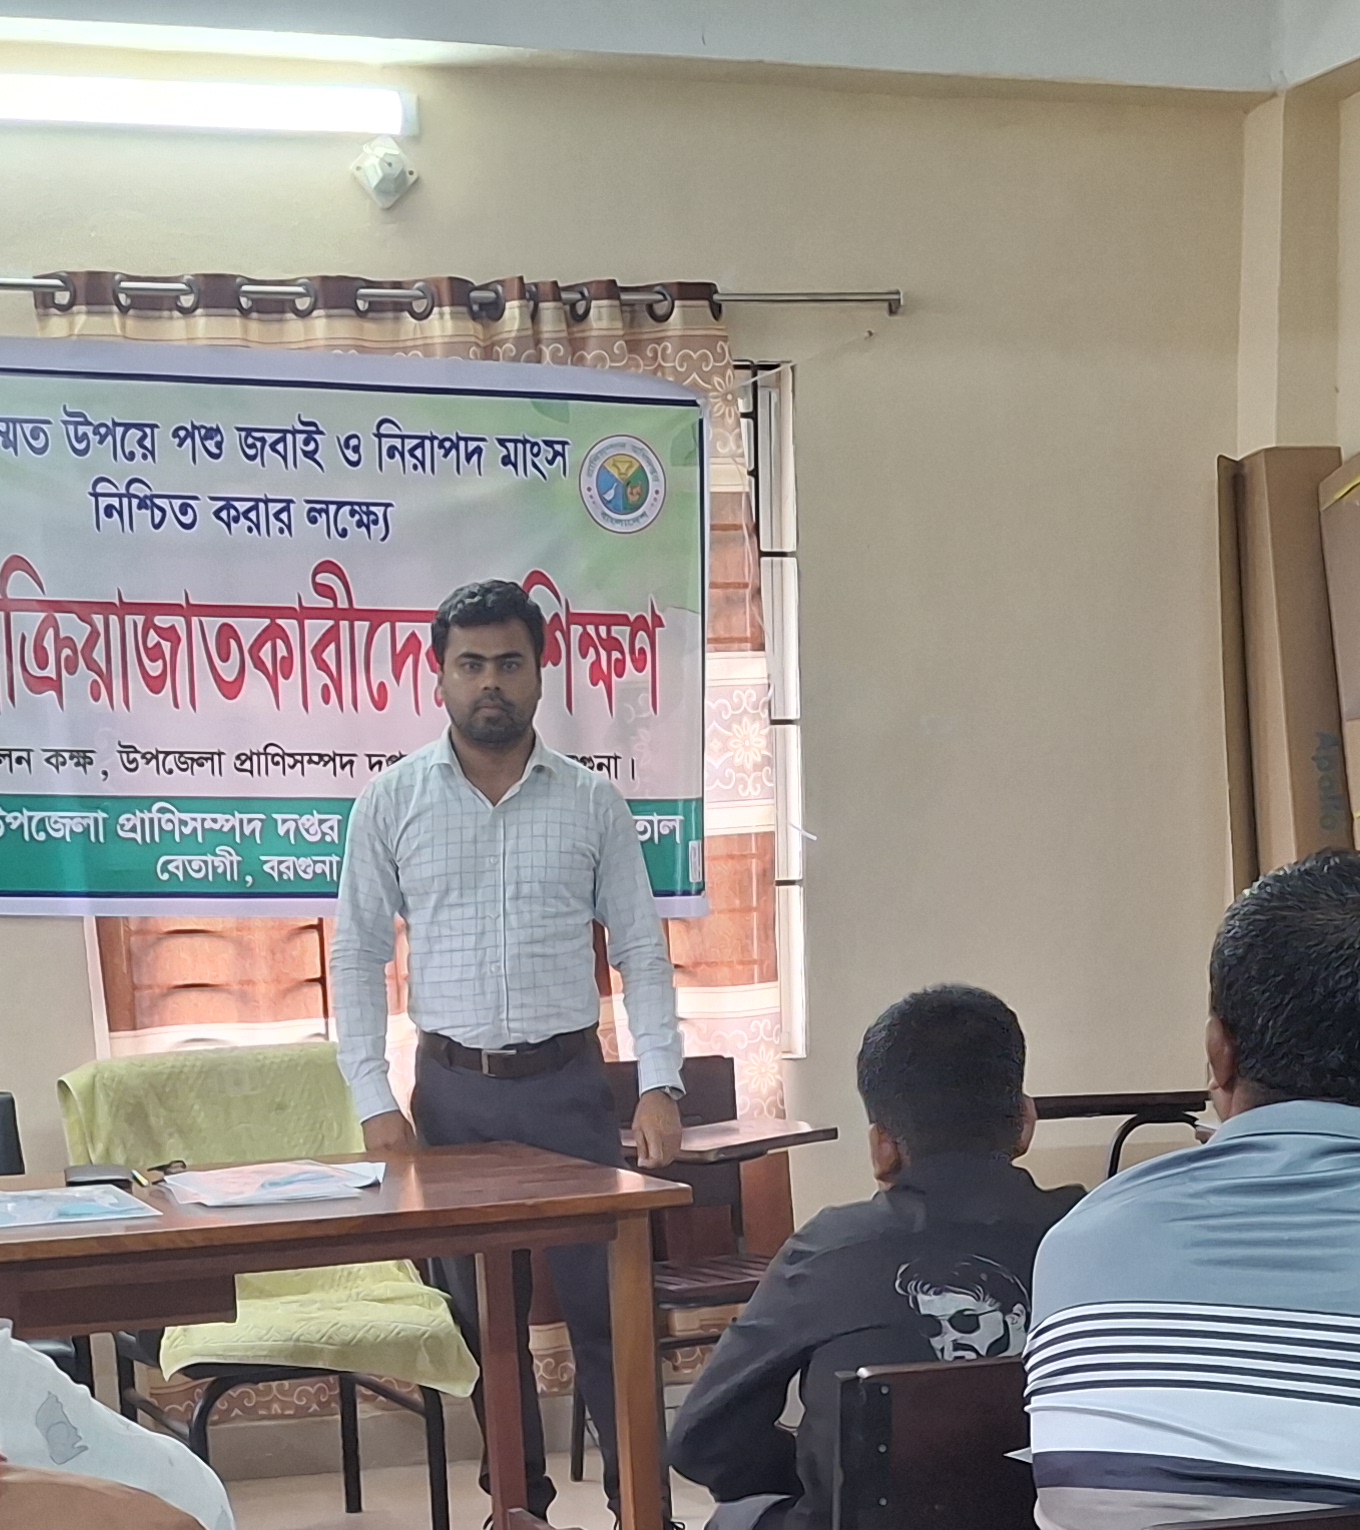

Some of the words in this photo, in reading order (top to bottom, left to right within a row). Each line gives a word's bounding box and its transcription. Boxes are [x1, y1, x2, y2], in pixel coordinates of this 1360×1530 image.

[61, 404, 160, 463] উপয়ে
[172, 418, 224, 465] পশু
[235, 413, 326, 473] জবাই
[337, 423, 362, 470] ও
[373, 417, 489, 477] নিরাপদ
[495, 436, 572, 481] মাংস
[89, 476, 201, 533] নিশ্চিত
[207, 494, 296, 538] করার
[303, 498, 395, 543] লক্ষ্যে
[116, 741, 226, 777] উপজেলা
[233, 743, 359, 779] প্রাণিসম্পদ
[115, 801, 267, 846] প্রাণিসম্পদ
[272, 809, 343, 845] দপ্তর
[259, 853, 342, 883] বরগুনা
